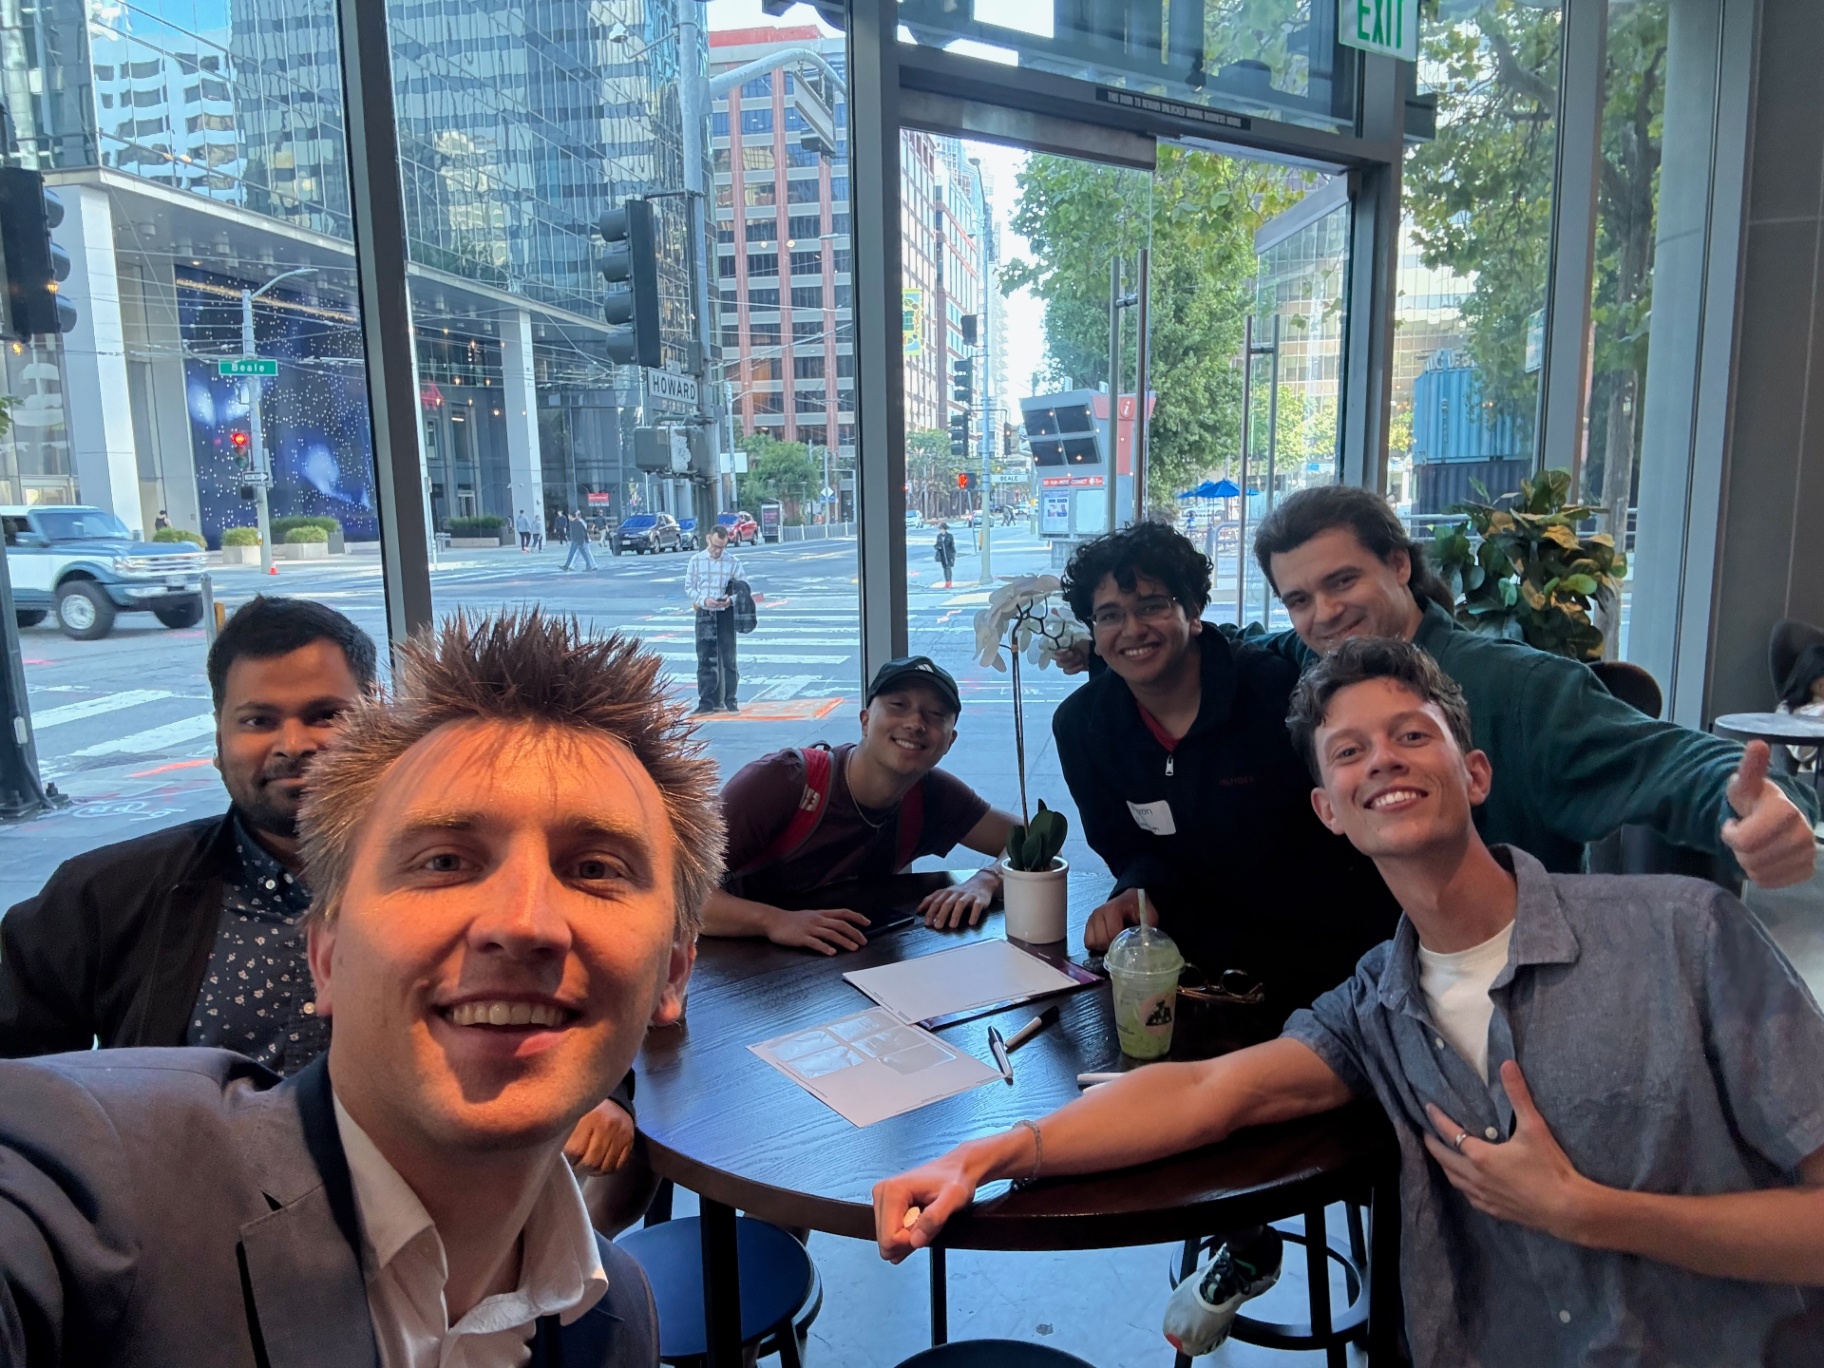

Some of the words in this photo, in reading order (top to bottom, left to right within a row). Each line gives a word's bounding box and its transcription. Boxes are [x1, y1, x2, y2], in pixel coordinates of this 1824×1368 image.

[1357, 0, 1404, 49] EXIT
[231, 363, 265, 372] Beale
[652, 374, 696, 400] HOWARD
